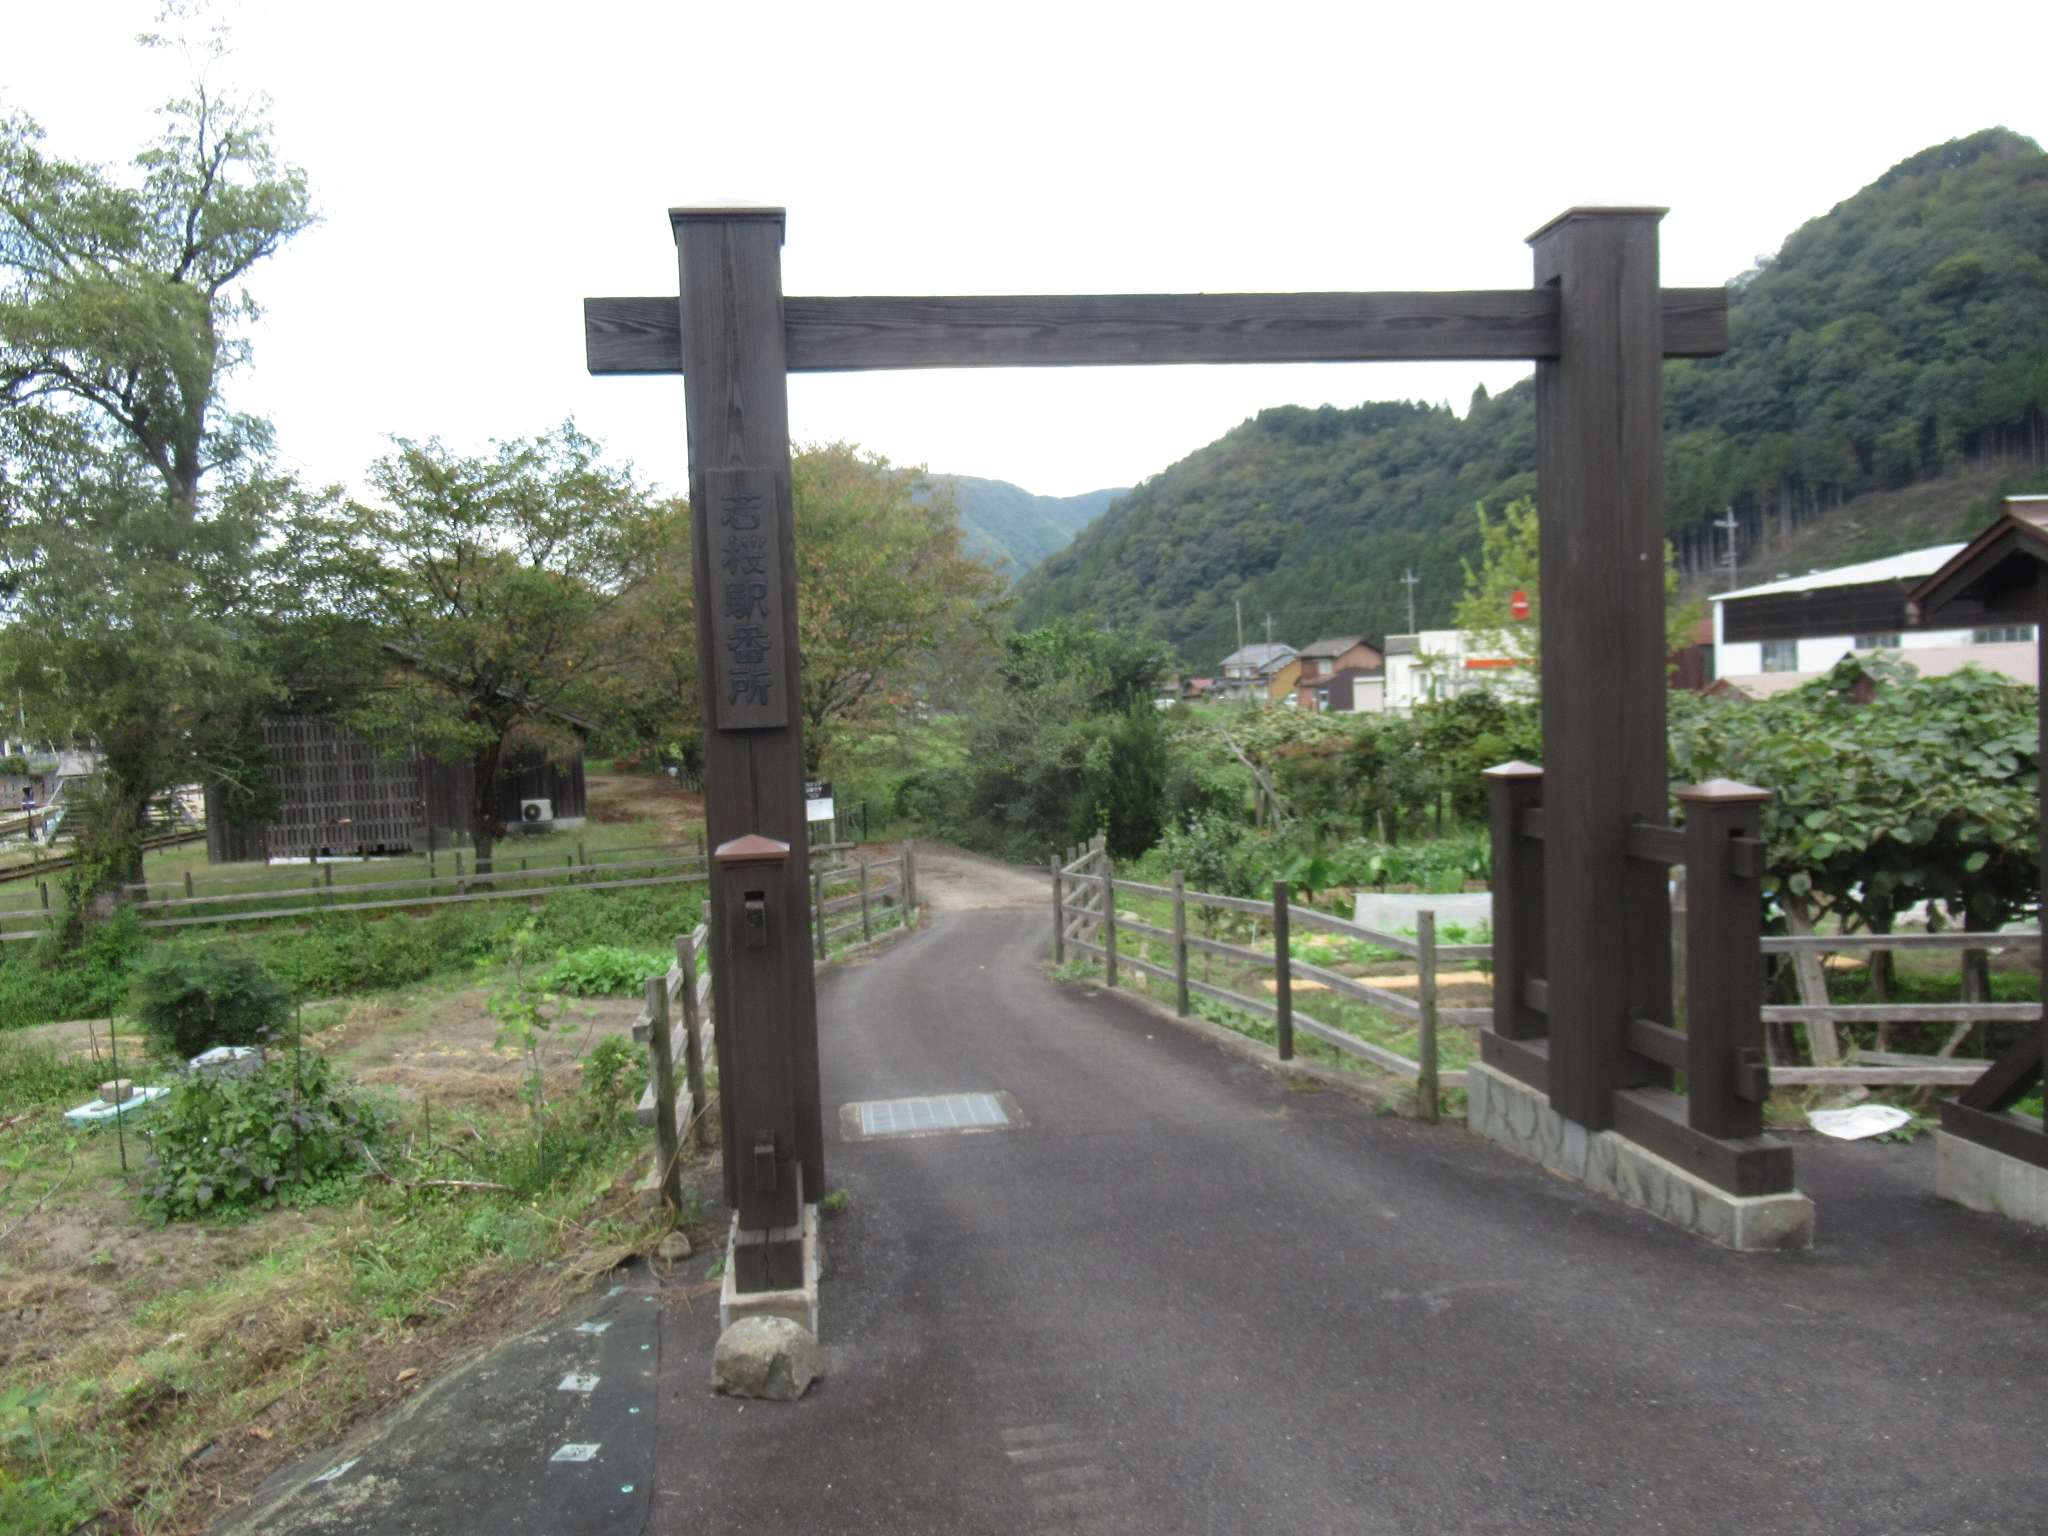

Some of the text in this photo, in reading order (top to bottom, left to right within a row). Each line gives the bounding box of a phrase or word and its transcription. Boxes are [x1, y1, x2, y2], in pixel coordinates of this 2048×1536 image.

[720, 494, 772, 706] 若桜駅番所
